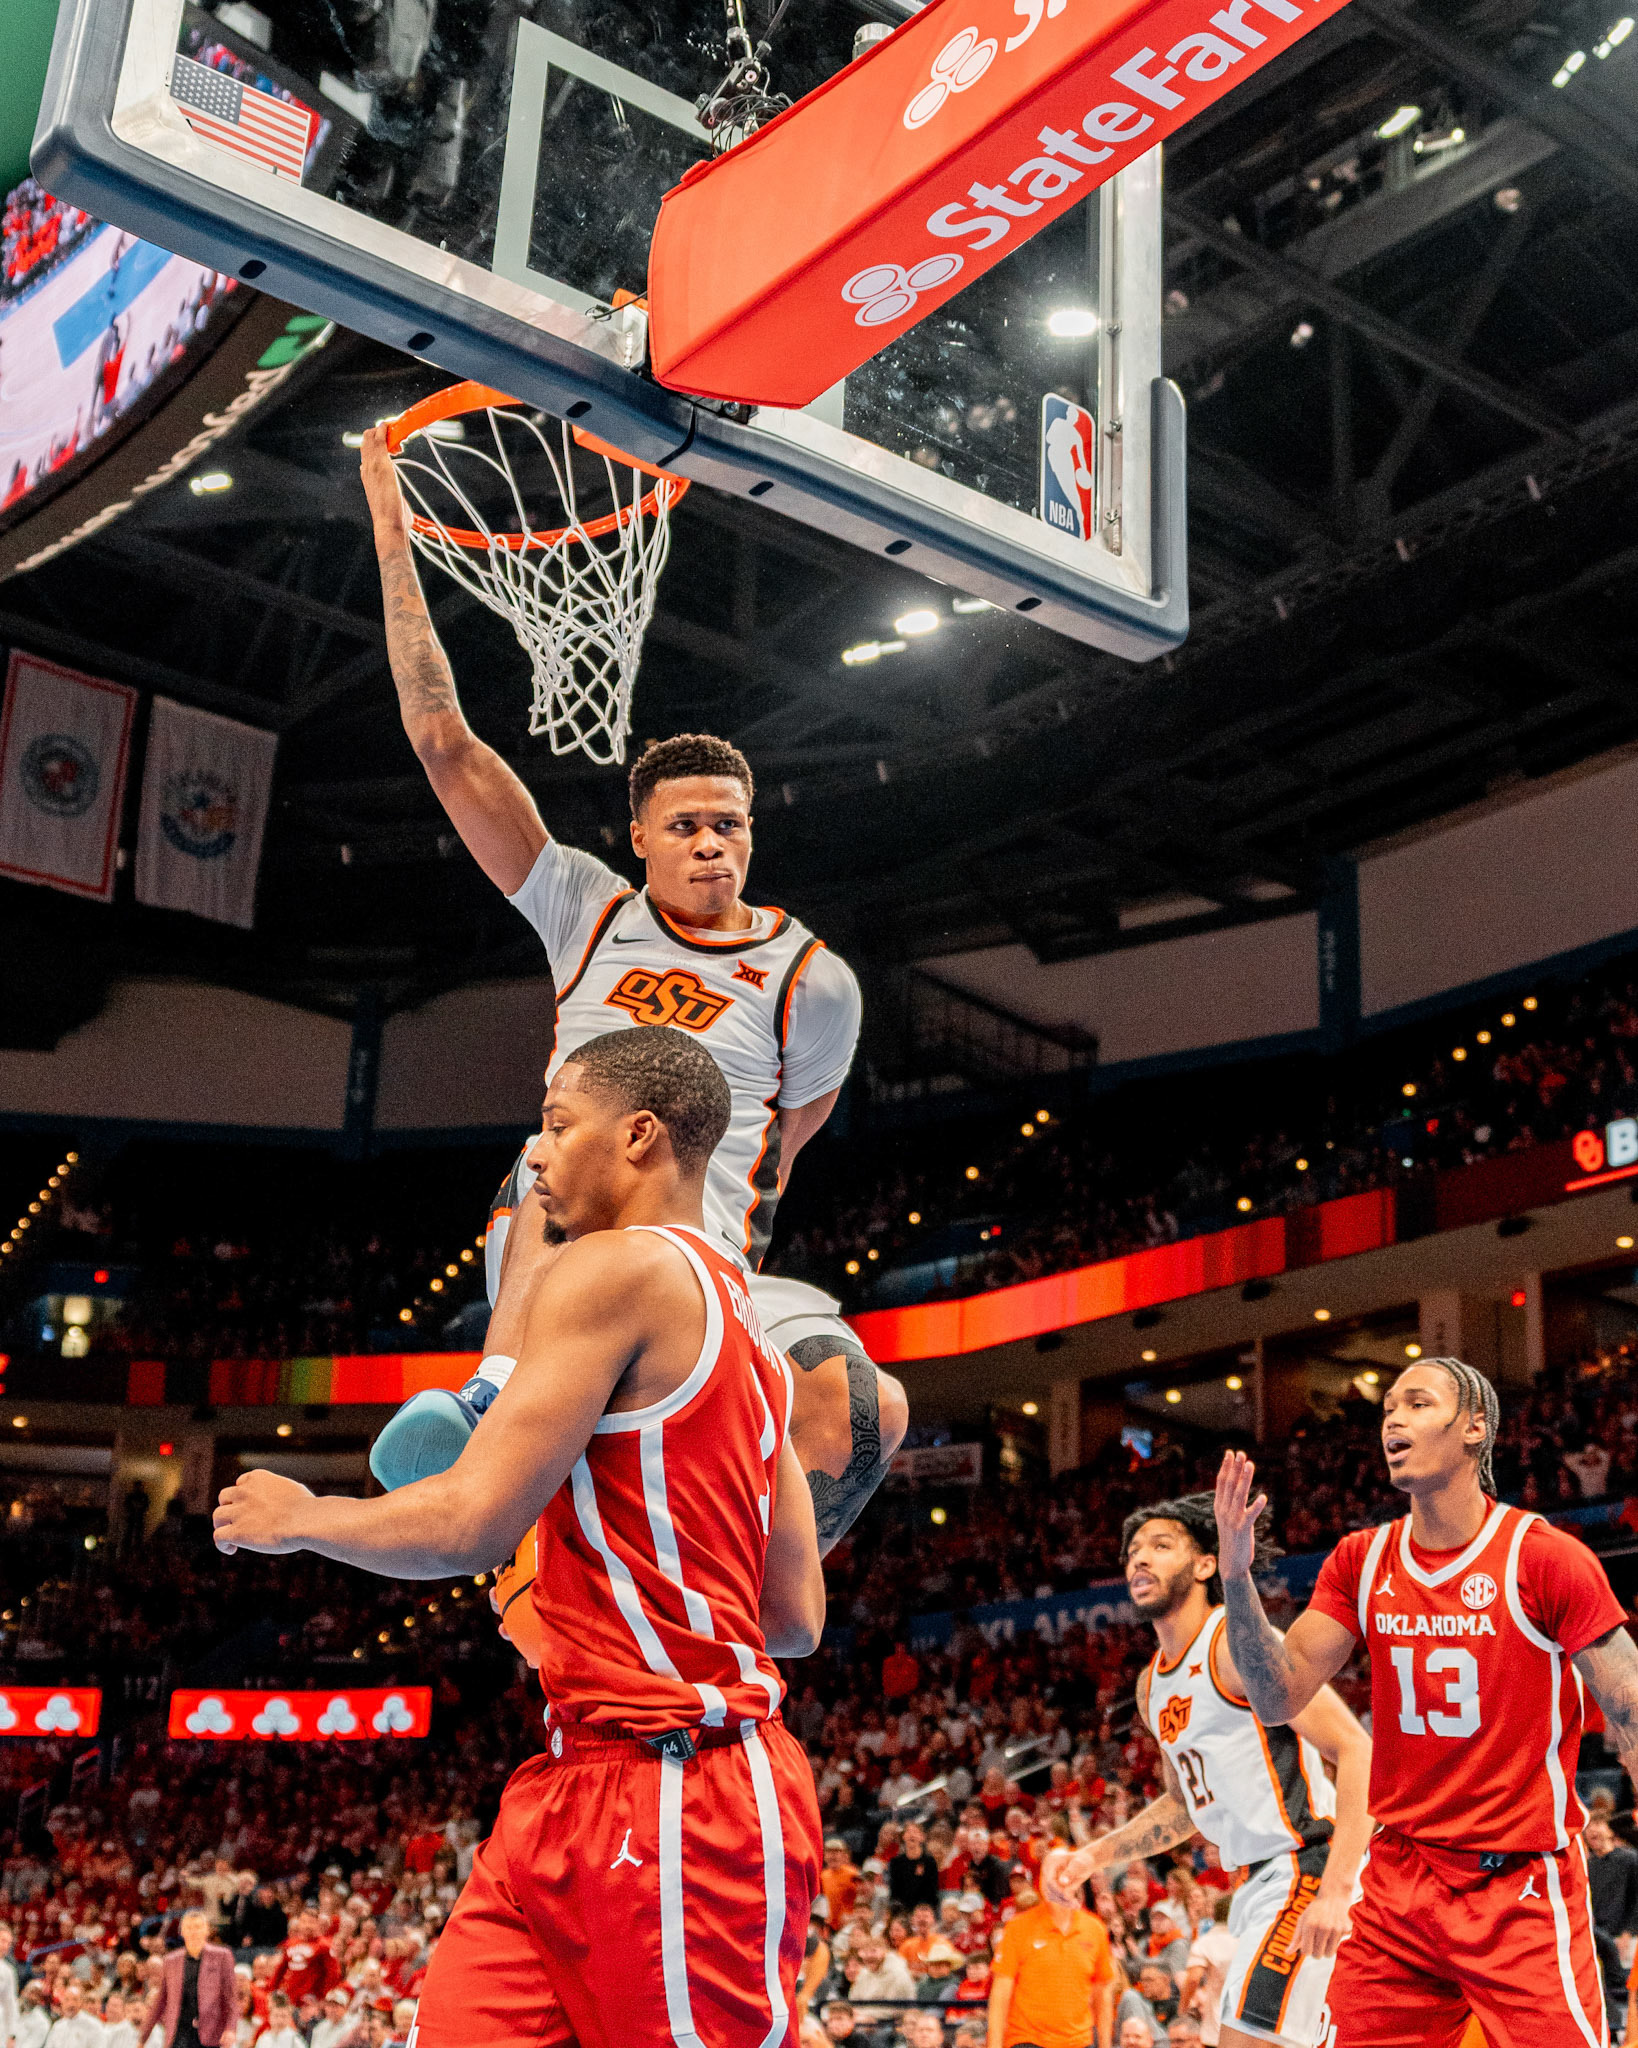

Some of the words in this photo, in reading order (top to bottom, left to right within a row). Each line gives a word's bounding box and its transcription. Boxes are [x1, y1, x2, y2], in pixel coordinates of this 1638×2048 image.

[1049, 499, 1075, 532] NBA
[604, 968, 735, 1033] OSU
[1462, 1574, 1496, 1608] SEC
[1375, 1613, 1497, 1637] OKLAHOMA
[1390, 1645, 1482, 1739] 13
[1158, 1694, 1193, 1744] OSU
[662, 1741, 679, 1755] 44
[1177, 1748, 1216, 1811] 21
